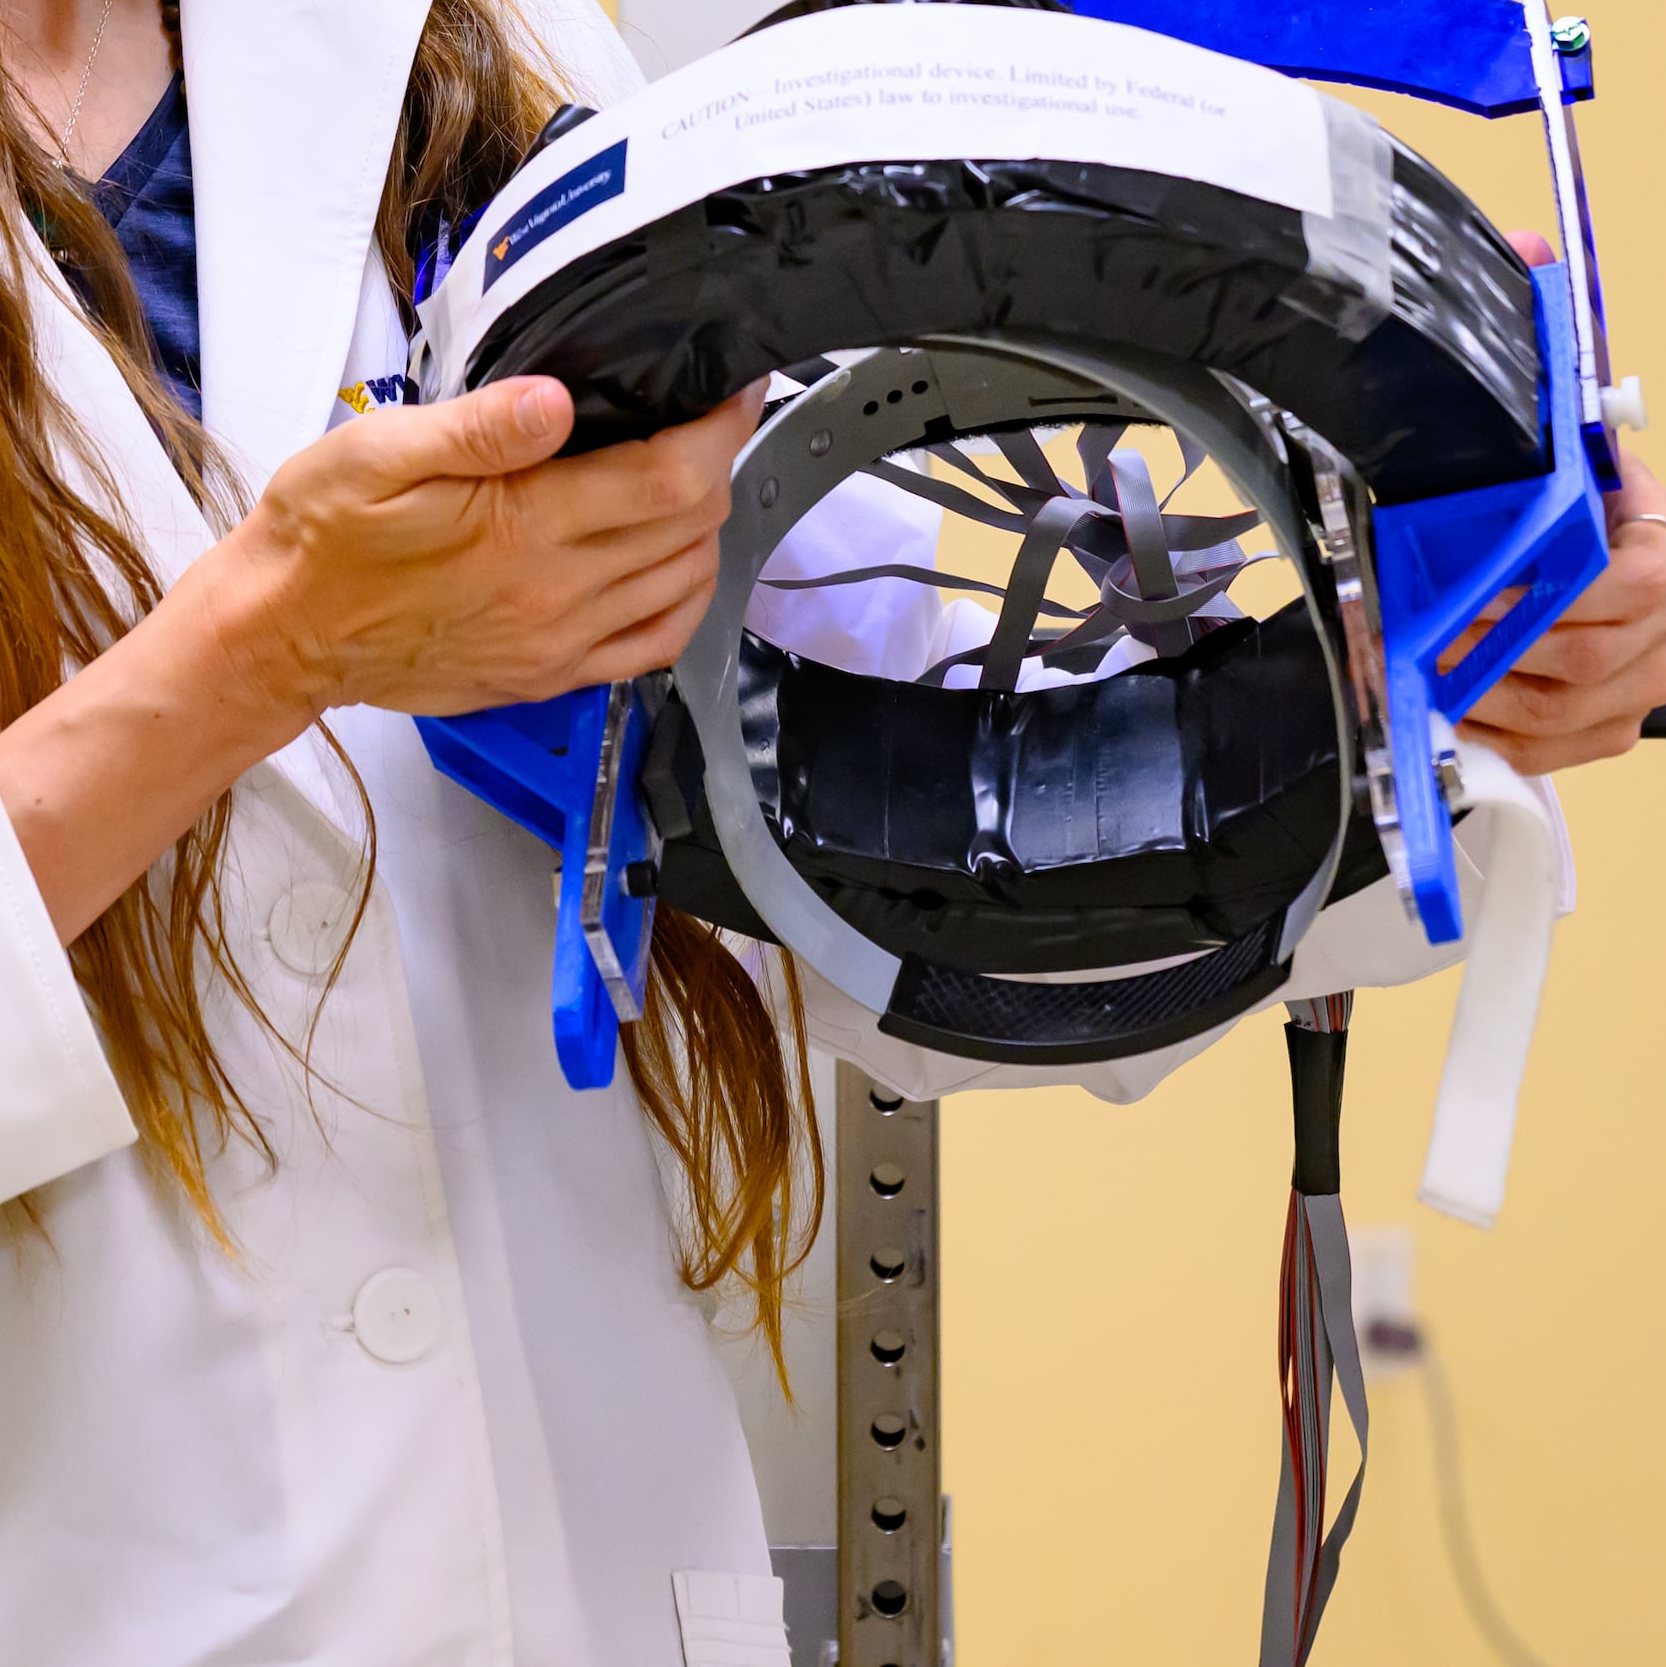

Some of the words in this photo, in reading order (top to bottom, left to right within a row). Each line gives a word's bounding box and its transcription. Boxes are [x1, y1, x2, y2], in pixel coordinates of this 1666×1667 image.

[734, 102, 798, 132] United
[805, 90, 872, 114] States)
[879, 88, 913, 105] law
[921, 89, 942, 105] to
[949, 87, 1098, 114] investigational
[1105, 104, 1144, 121] use.
[1010, 65, 1086, 90] Limited
[1095, 77, 1117, 96] by
[1127, 78, 1195, 111] Federal
